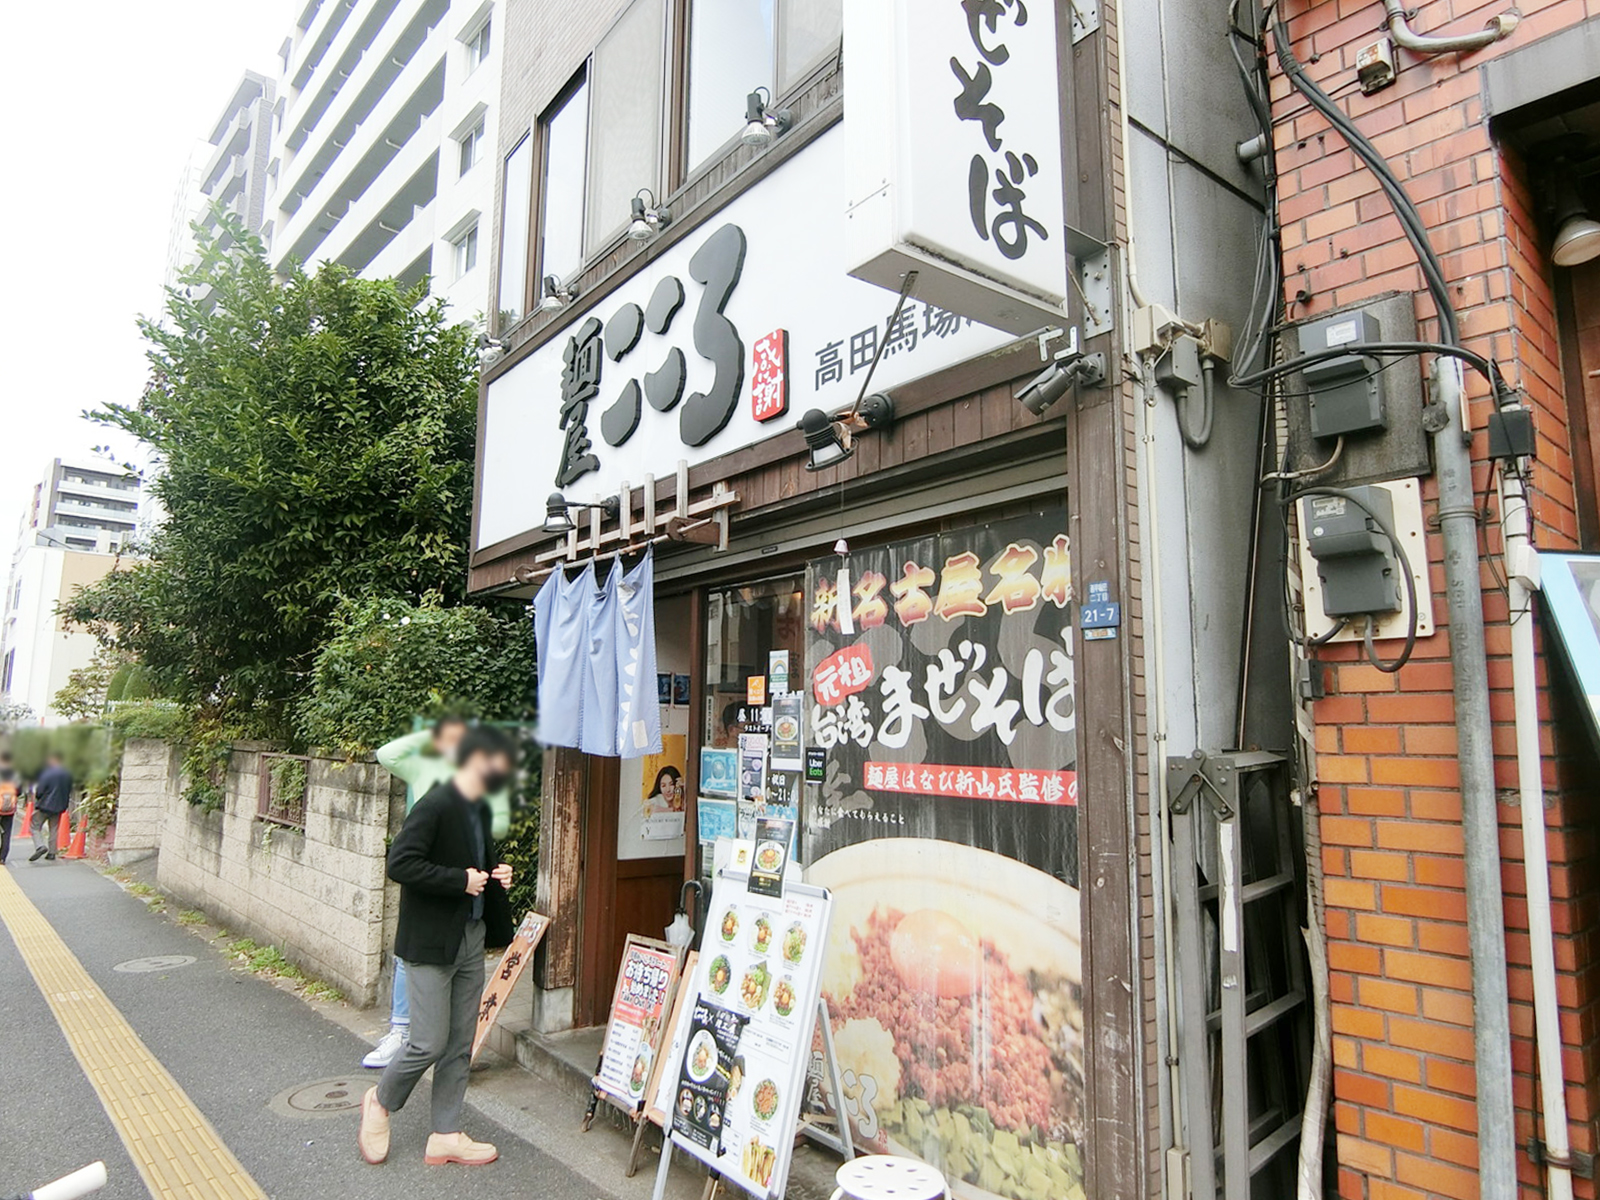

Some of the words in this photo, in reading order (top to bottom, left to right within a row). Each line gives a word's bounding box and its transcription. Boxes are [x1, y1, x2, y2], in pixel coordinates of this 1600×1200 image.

[815, 303, 974, 391] 高田馬場
[1084, 607, 1114, 623] 21-7
[815, 655, 873, 702] 元祖
[811, 696, 873, 749] 台湾
[809, 758, 823, 767] Uber
[809, 767, 823, 776] Eats
